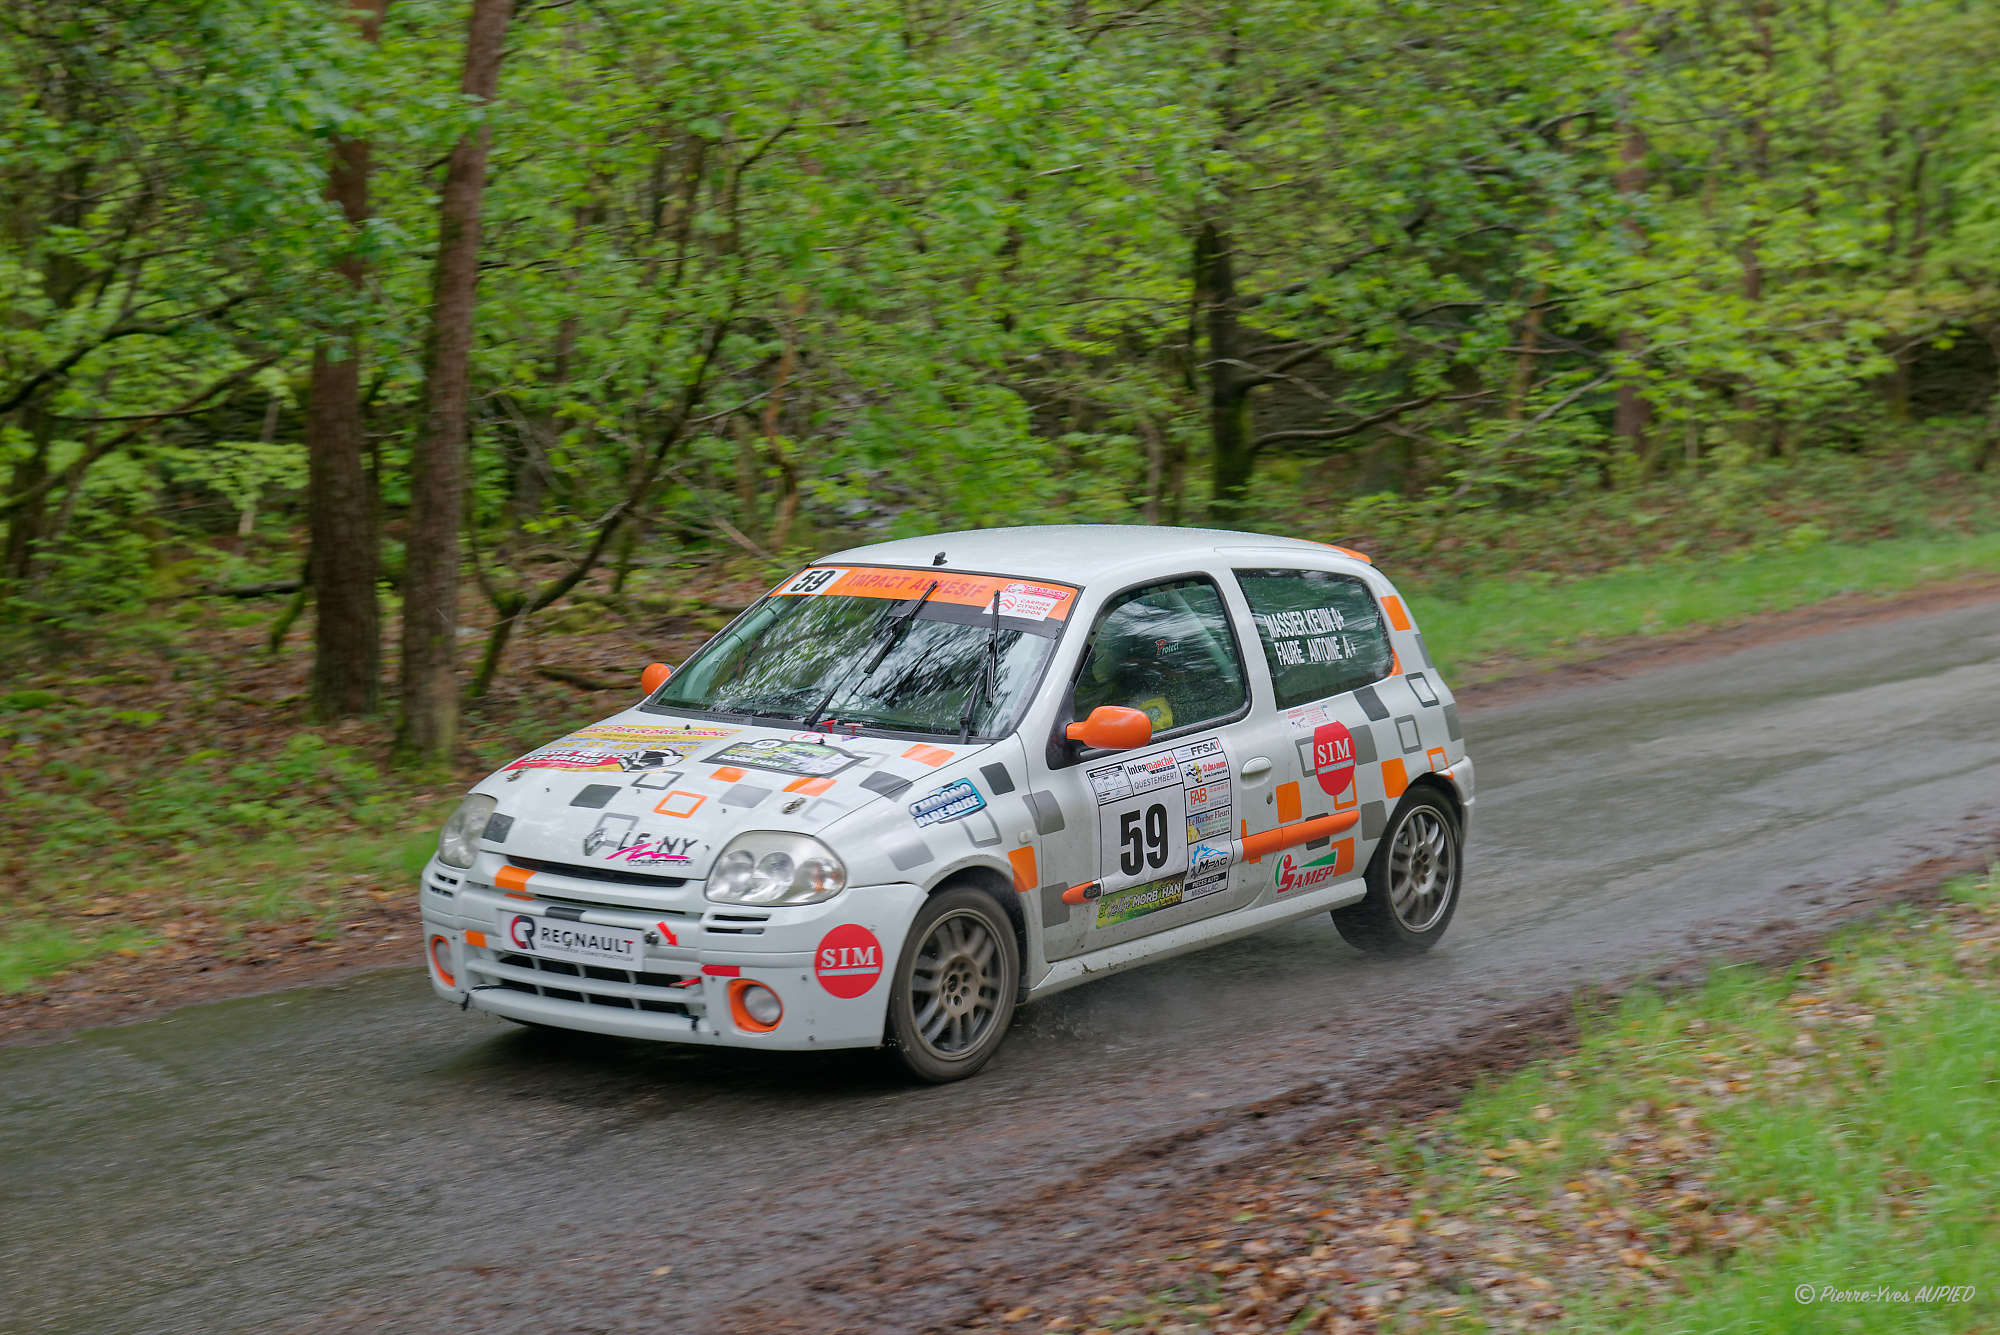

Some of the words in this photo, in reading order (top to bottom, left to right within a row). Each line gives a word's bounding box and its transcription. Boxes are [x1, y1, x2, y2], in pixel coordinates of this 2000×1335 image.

[790, 570, 836, 592] 59
[846, 574, 912, 589] IMPACT
[1307, 636, 1343, 662] ANTOINE
[1191, 741, 1218, 756] FFSA
[1317, 737, 1351, 765] SIM
[1134, 772, 1177, 789] QUESTEMBERT
[1190, 787, 1208, 807] FAB
[656, 836, 698, 856] NY
[1120, 803, 1168, 876] 59
[541, 927, 634, 954] REGNAULT
[821, 946, 876, 967] SIM
